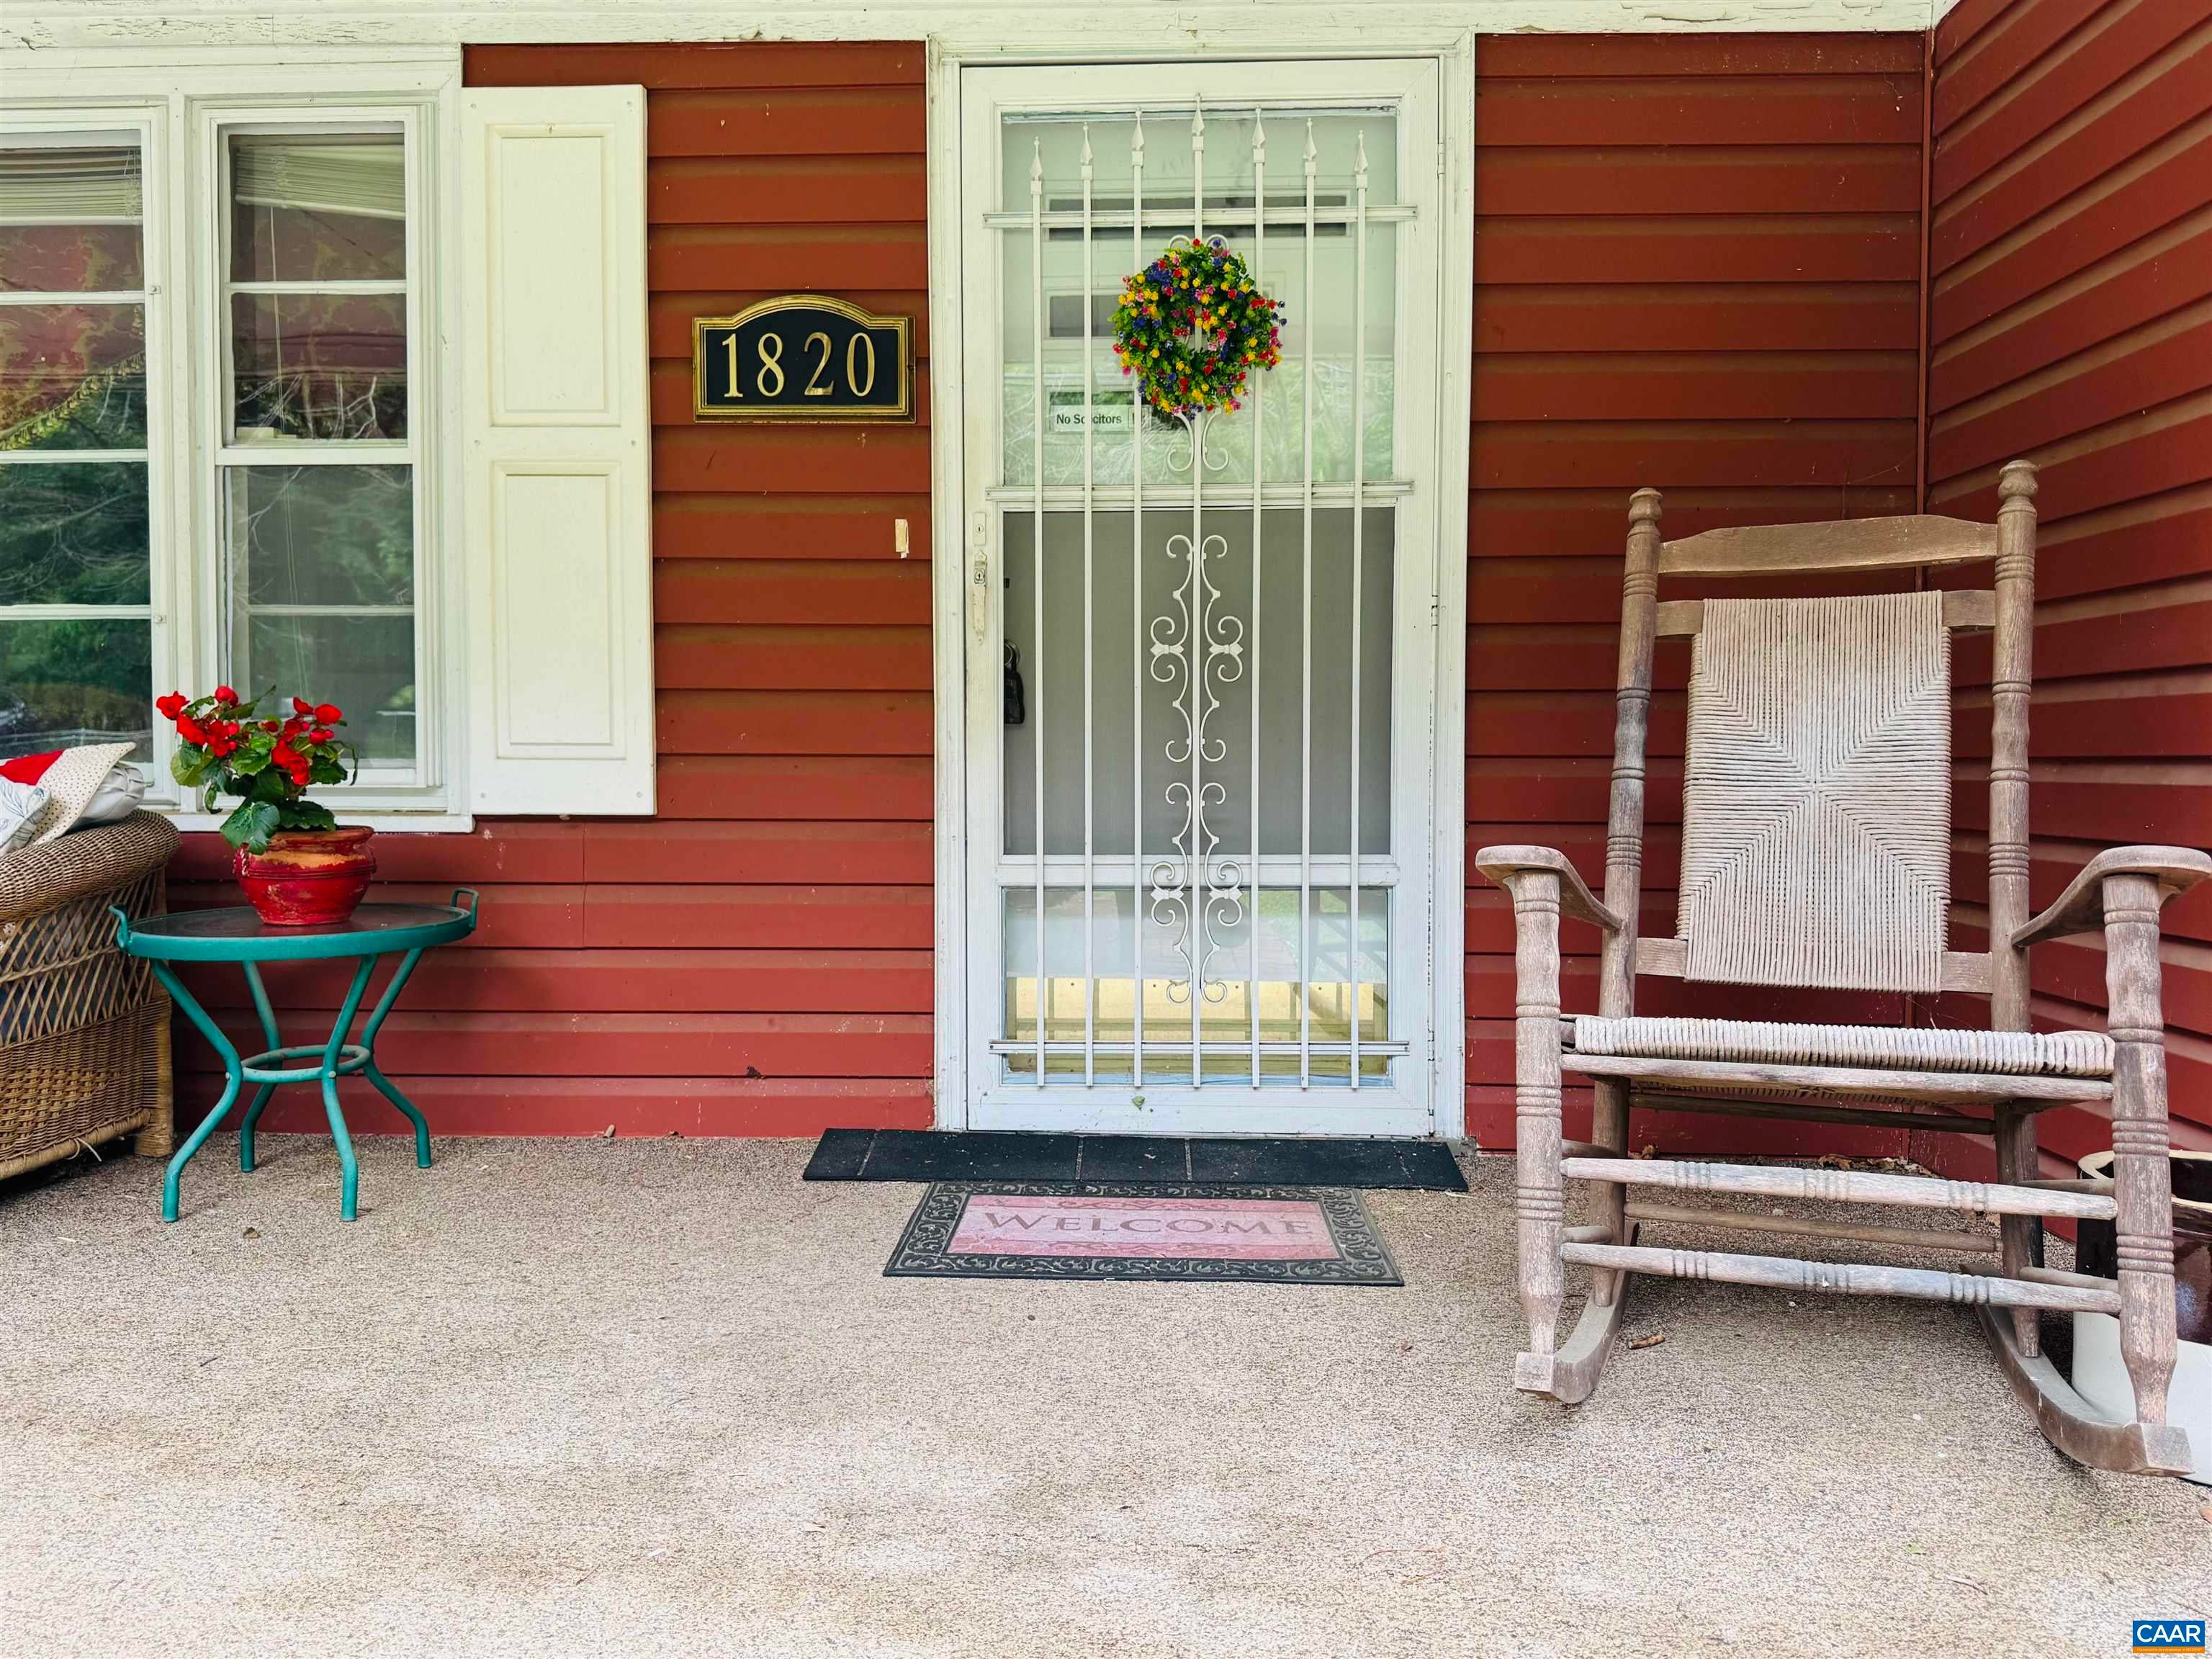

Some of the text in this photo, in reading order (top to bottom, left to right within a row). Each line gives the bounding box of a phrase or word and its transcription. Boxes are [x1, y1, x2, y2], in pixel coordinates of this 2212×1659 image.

[722, 333, 875, 397] 1820
[1056, 413, 1123, 425] No Socitors
[985, 1213, 1315, 1234] WELCOME
